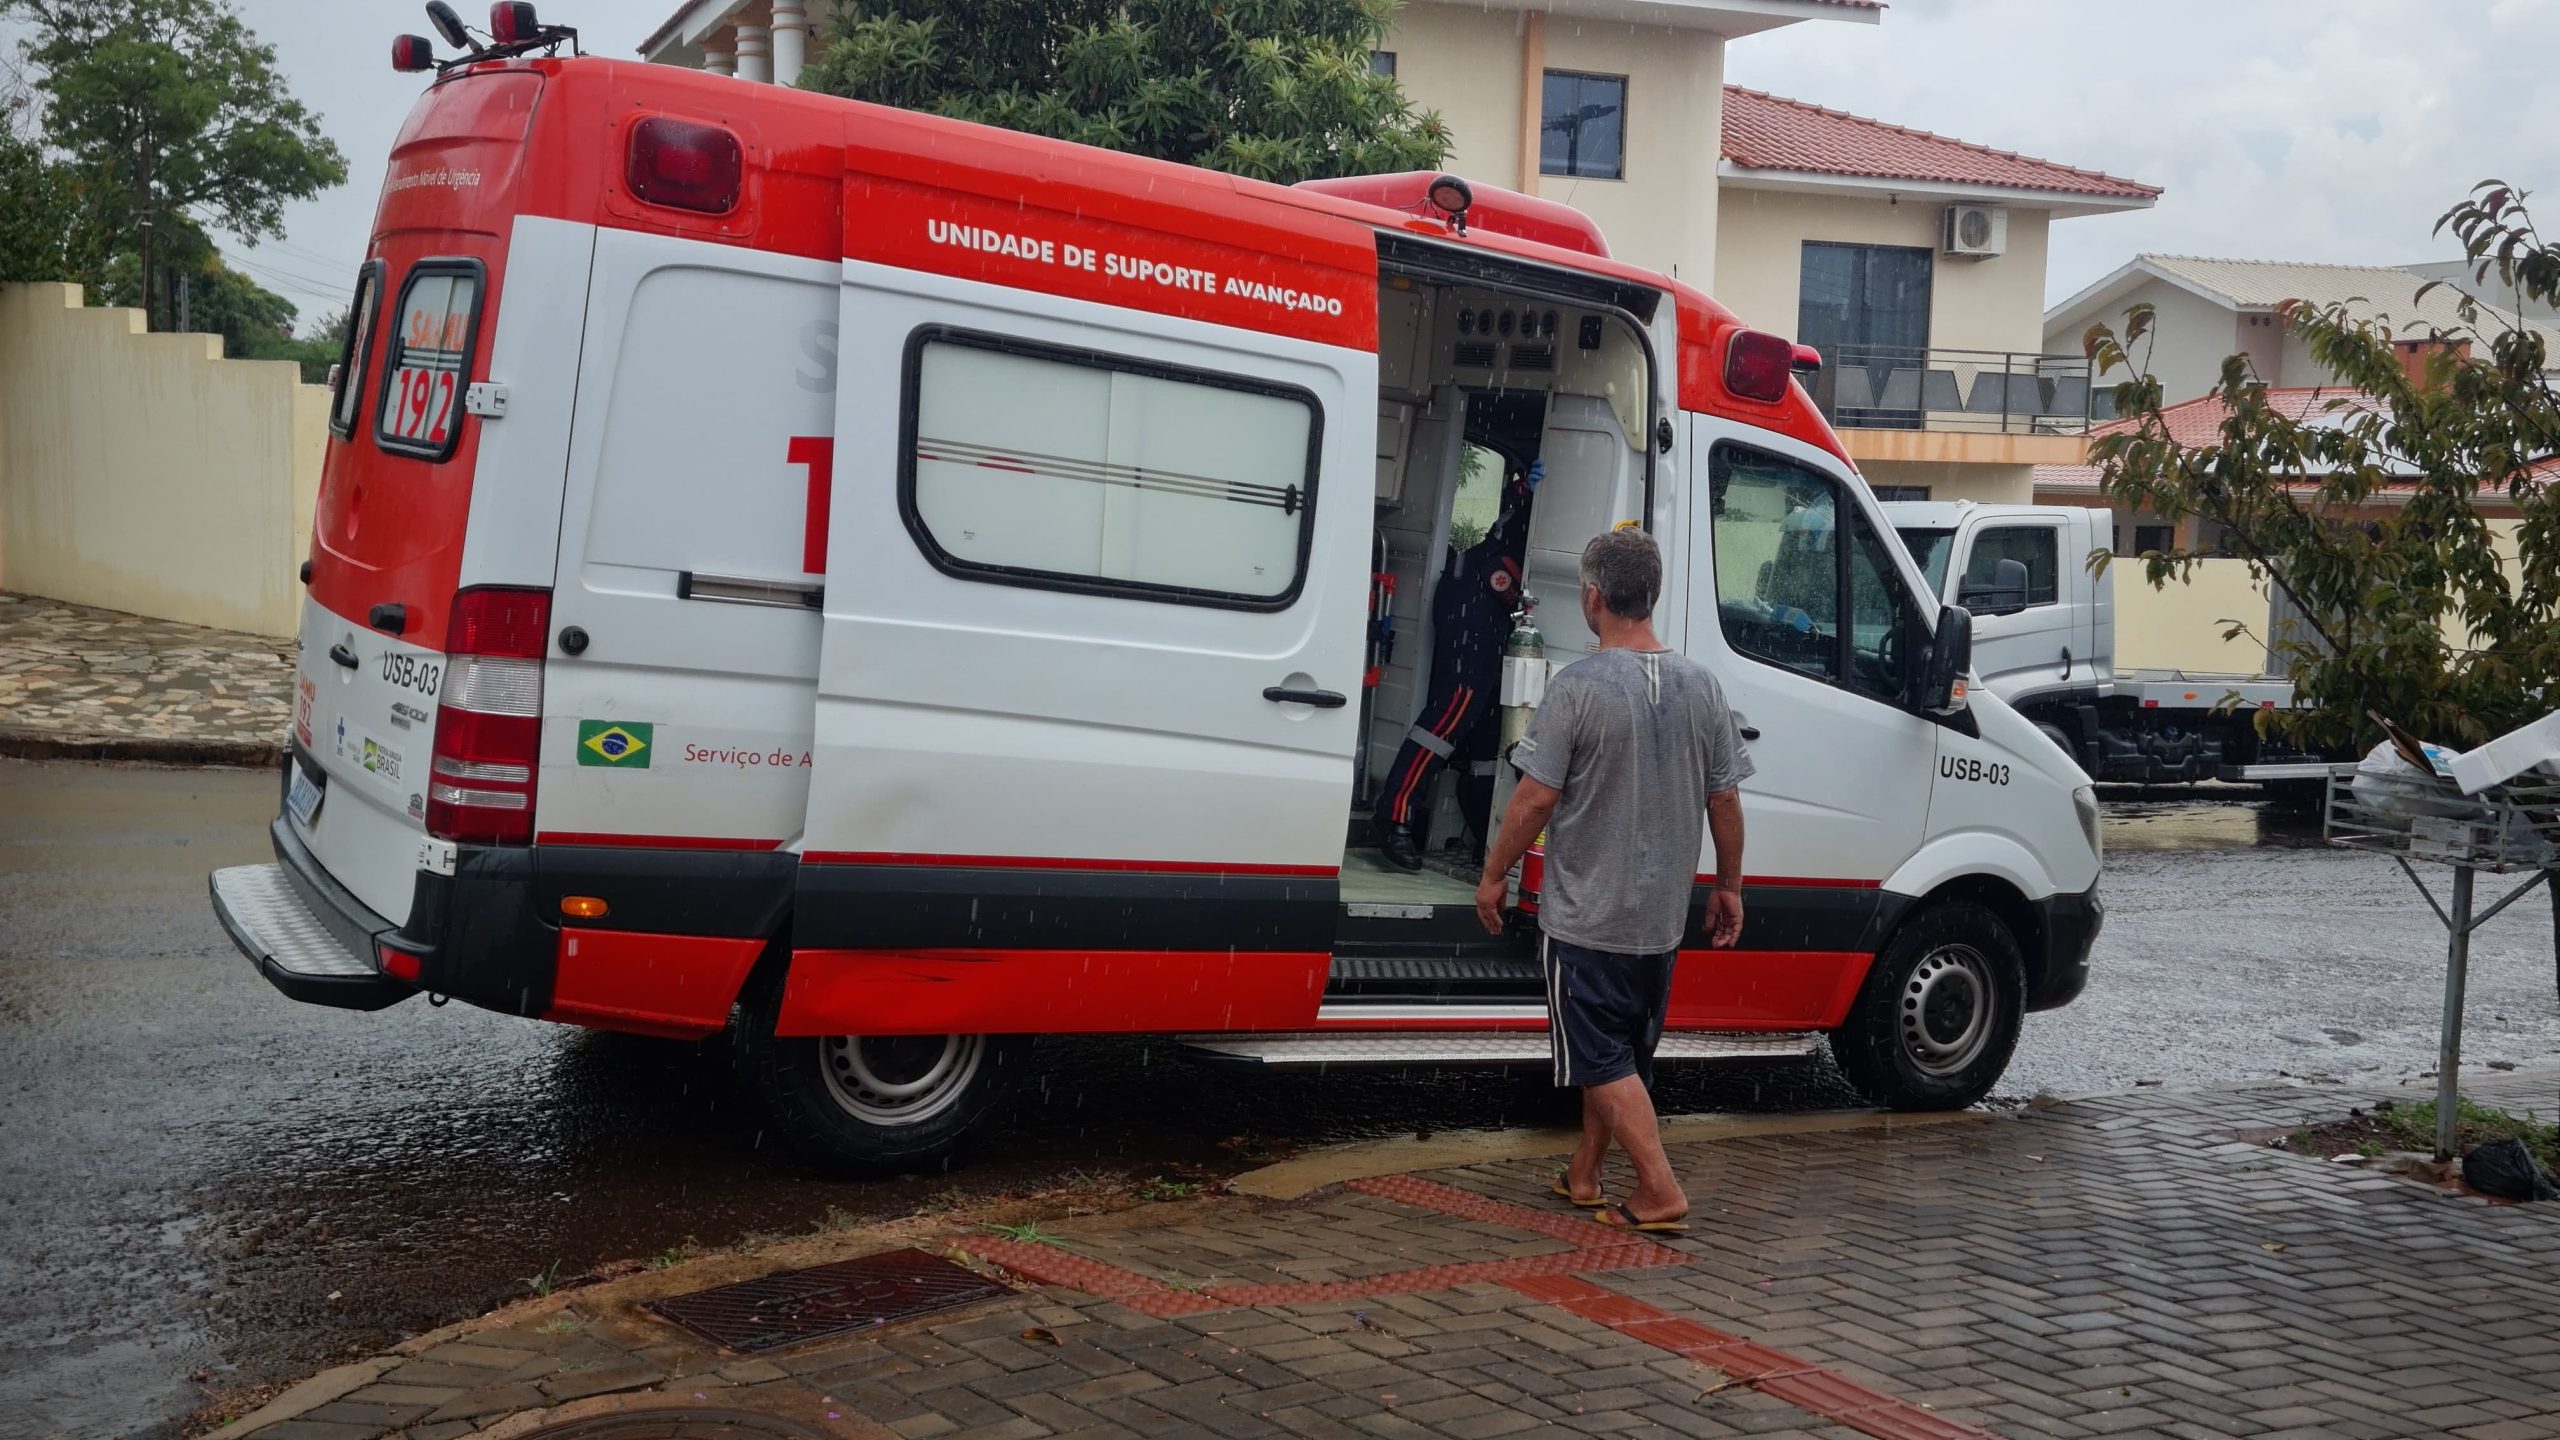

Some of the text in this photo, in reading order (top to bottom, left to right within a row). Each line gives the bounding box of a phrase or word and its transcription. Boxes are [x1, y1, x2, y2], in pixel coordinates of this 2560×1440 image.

[437, 167, 447, 185] de
[447, 167, 481, 191] Urgência
[927, 219, 1342, 316] UNIDADE DE SUPORTE AVANÇADO
[408, 310, 469, 352] SAMU
[394, 368, 454, 442] 192
[382, 650, 439, 696] USB-03
[377, 754, 401, 780] BRASIL
[684, 744, 813, 769] Serviço de A
[1940, 755, 2010, 786] USB-03
